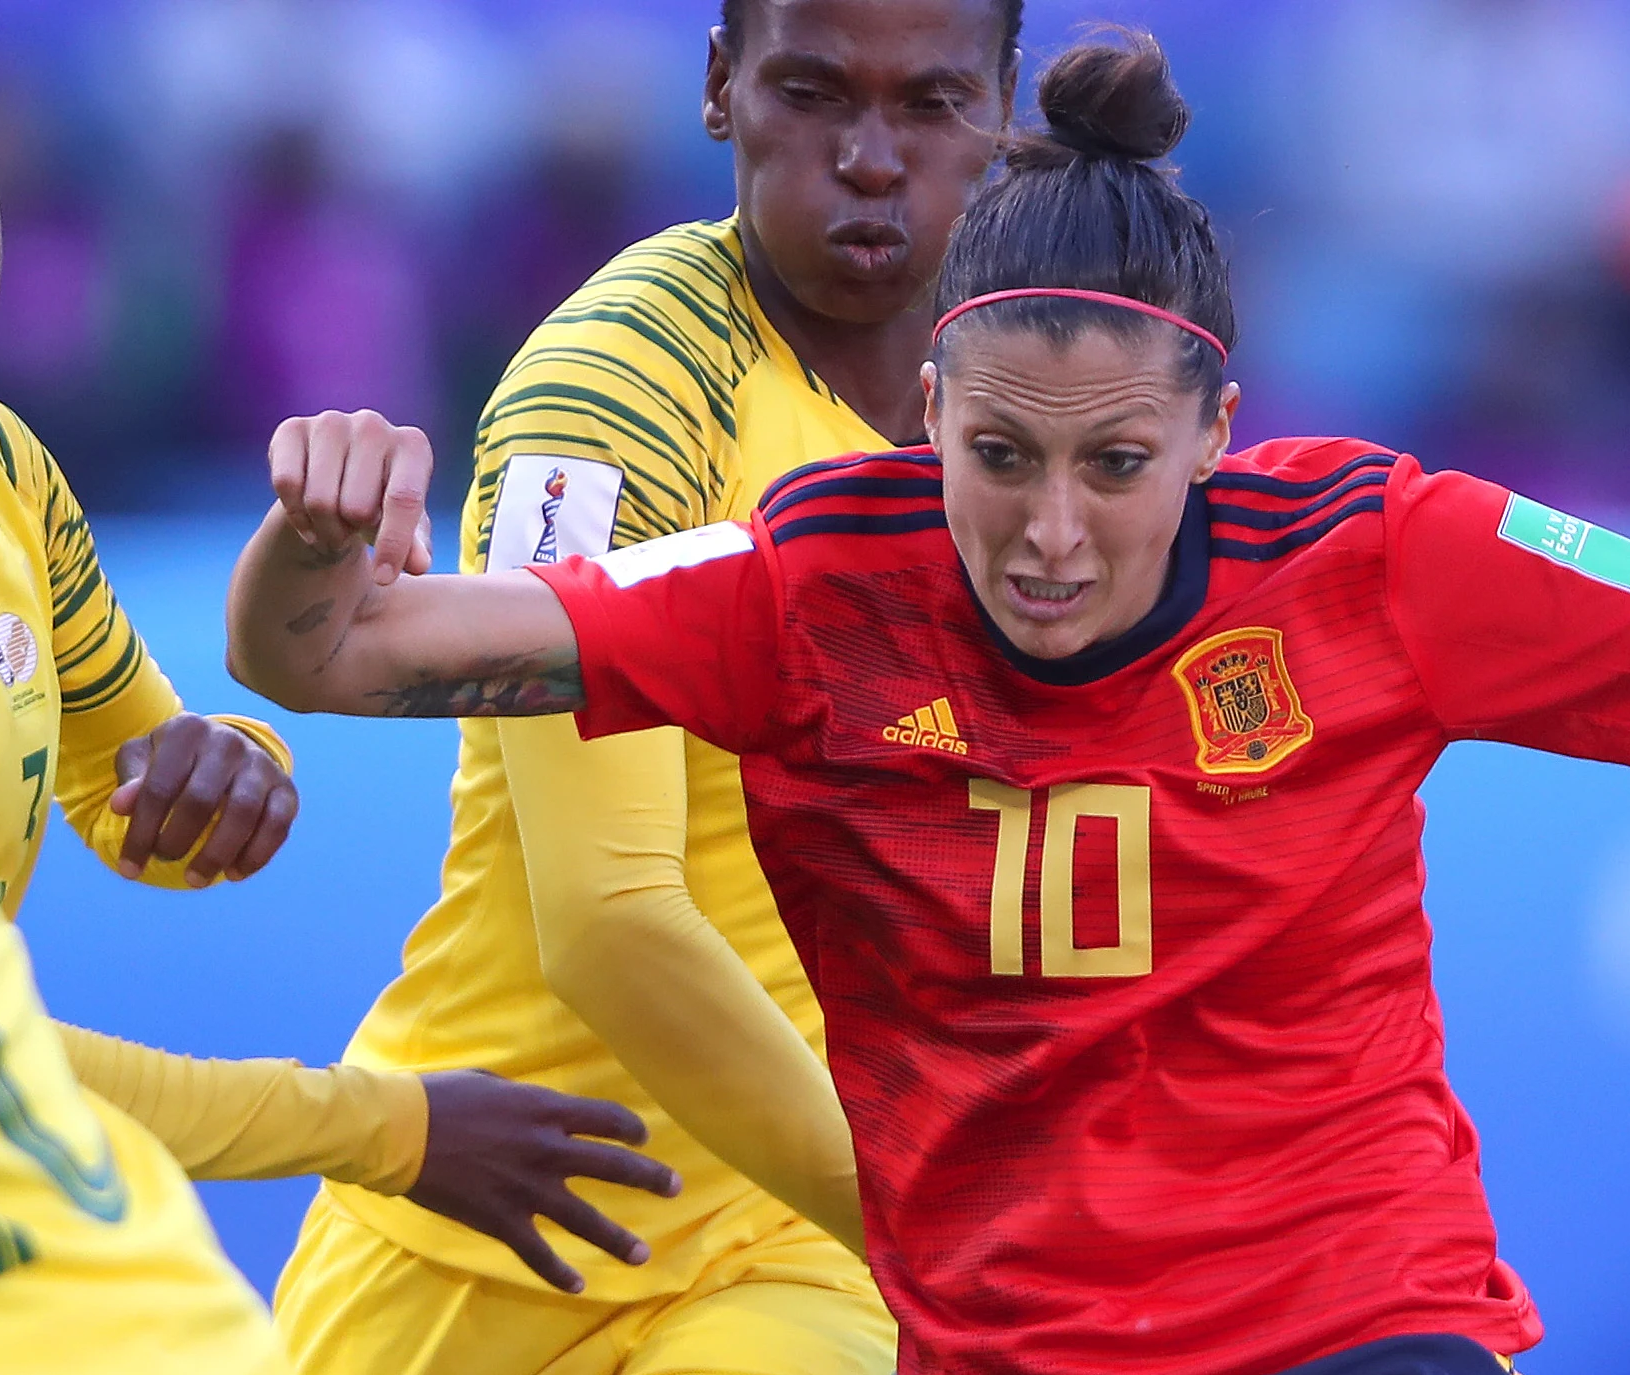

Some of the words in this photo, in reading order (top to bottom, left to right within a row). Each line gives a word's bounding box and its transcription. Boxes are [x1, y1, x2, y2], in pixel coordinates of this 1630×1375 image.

[882, 725, 968, 755] adidas
[22, 745, 48, 842] 7
[1196, 781, 1230, 796] SPAIN
[968, 778, 1153, 978] 10
